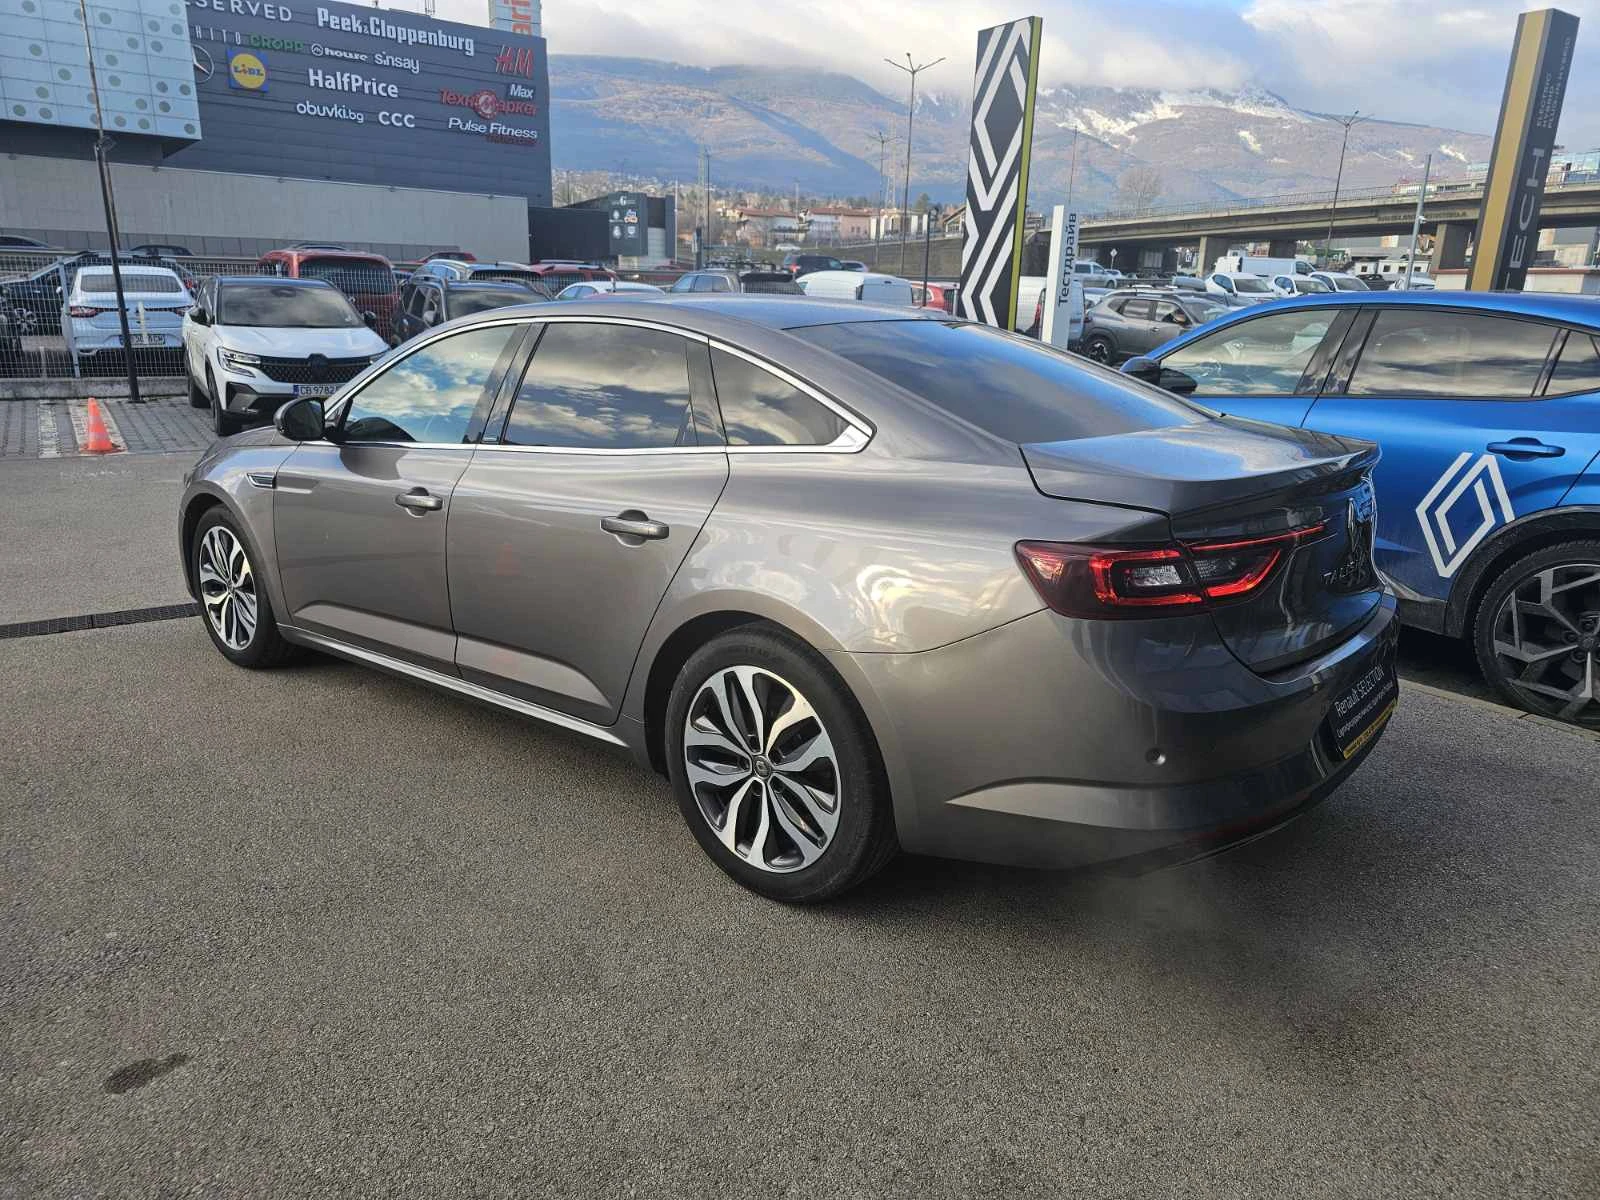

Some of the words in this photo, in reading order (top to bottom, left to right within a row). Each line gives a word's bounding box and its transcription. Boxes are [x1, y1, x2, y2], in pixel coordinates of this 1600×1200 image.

[185, 0, 292, 21] SERVED
[495, 45, 534, 79] H&M
[308, 68, 398, 98] HalfPrice
[510, 84, 534, 99] Max
[296, 101, 364, 123] obuvki.bg
[378, 111, 415, 128] CCC
[448, 117, 487, 134] Pulse
[490, 122, 537, 139] Fitness
[1058, 212, 1077, 308] Тестдрайв
[1334, 687, 1360, 717] Renault
[1357, 664, 1385, 699] SELECTION
